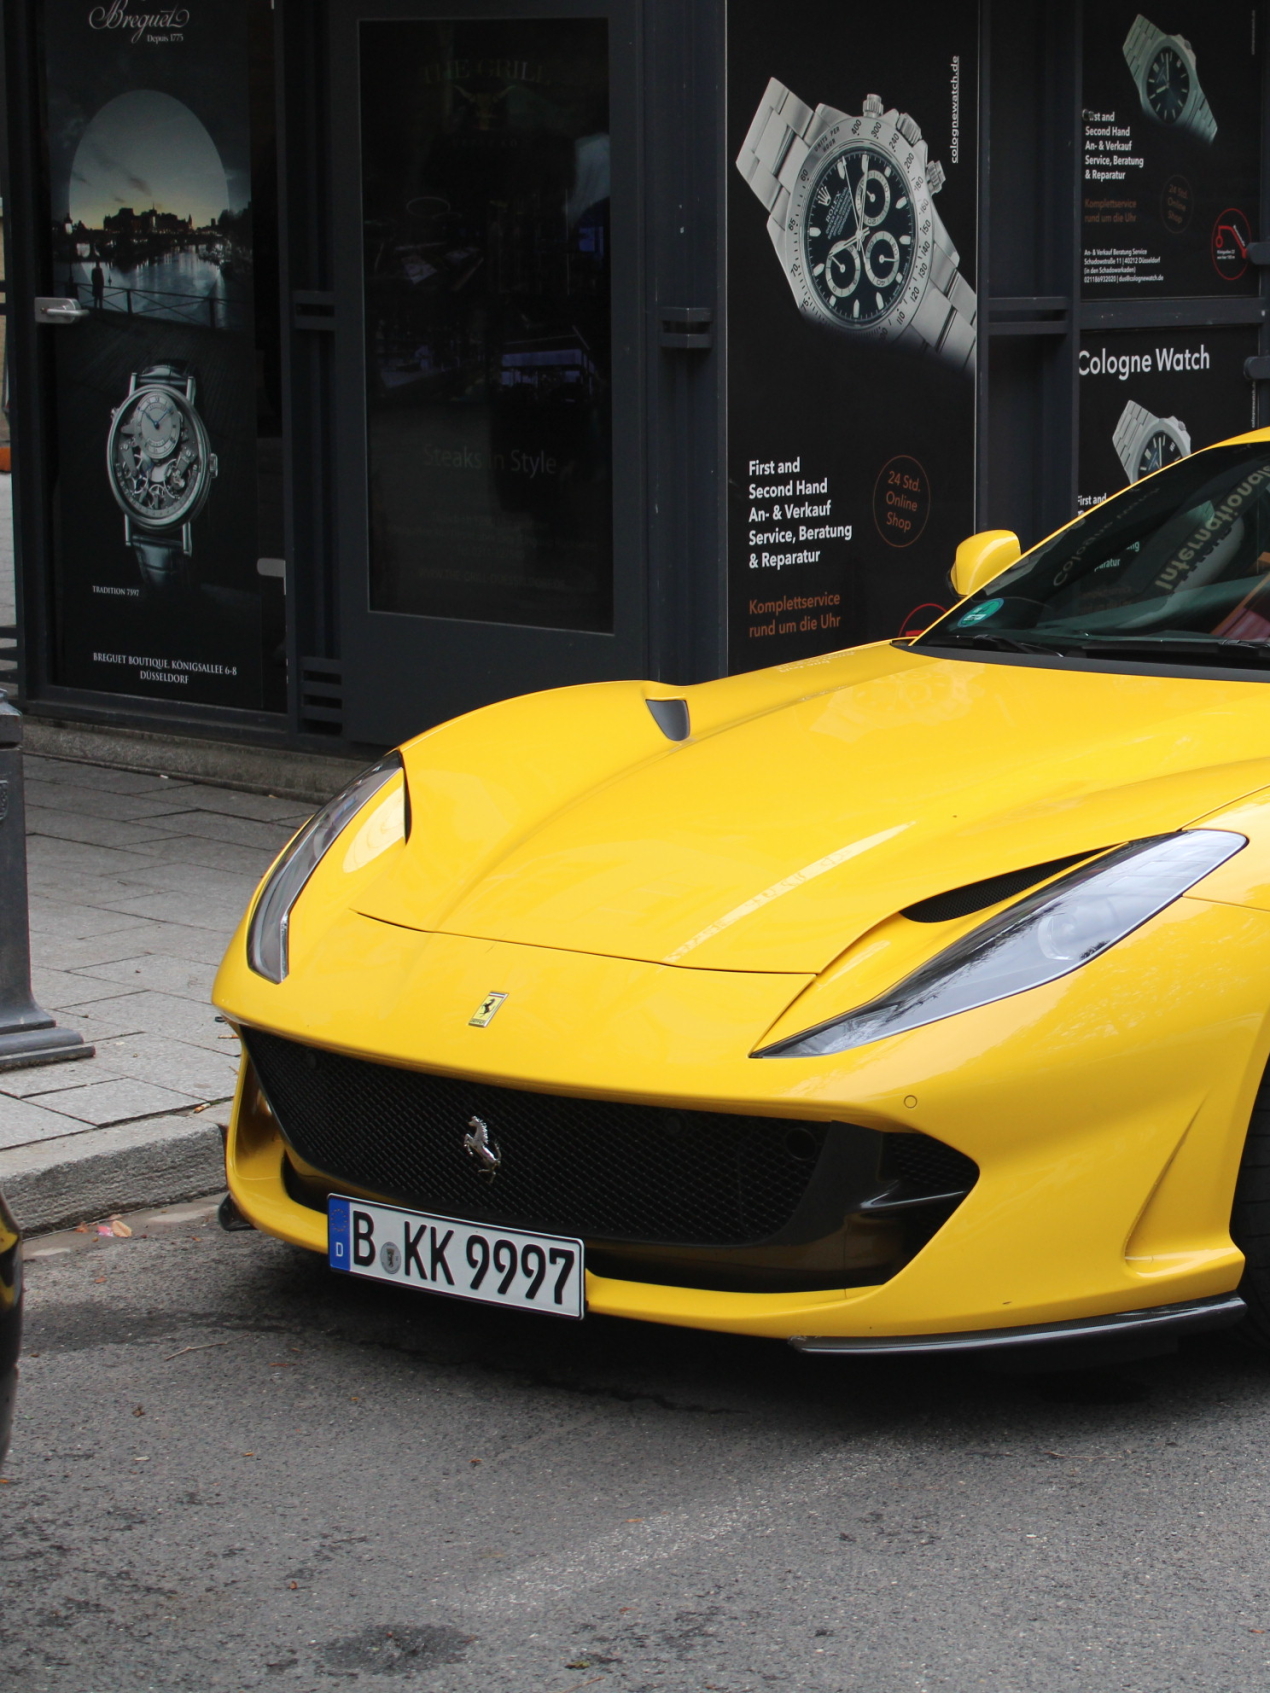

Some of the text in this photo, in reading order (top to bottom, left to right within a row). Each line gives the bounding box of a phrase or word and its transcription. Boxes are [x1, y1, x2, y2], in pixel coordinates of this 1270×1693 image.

[88, 0, 190, 44] Breguet
[950, 55, 960, 164] colognewatch.de
[1102, 111, 1115, 122] and
[1085, 126, 1130, 137] Second Hand
[1085, 140, 1132, 151] An- & Verkauf
[1085, 155, 1144, 168] Service, Beratung
[1085, 170, 1126, 182] & Reparatur
[1085, 198, 1137, 211] Komplettservice
[1168, 197, 1186, 213] Online
[1084, 213, 1100, 222] rund
[1113, 212, 1124, 222] die
[1125, 212, 1136, 222] Uhr
[1168, 211, 1182, 224] Shop
[1079, 344, 1210, 381] Cologne Watch
[423, 443, 483, 469] Steaks
[510, 449, 558, 479] Style
[749, 456, 801, 476] First and
[749, 478, 828, 500] Second Hand
[888, 470, 921, 492] 24 Std.
[748, 500, 832, 522] An- & Verkauf
[886, 490, 918, 512] Online
[886, 512, 912, 533] Shop
[749, 525, 852, 546] Service, Beratung
[749, 550, 820, 570] & Reparatur
[92, 586, 139, 596] TRADITION 7597
[749, 592, 840, 616] Komplettservice
[749, 612, 841, 638] rund um die Uhr
[93, 652, 127, 664] BREGUET
[172, 660, 224, 674] KÖNIGSALLEE
[224, 666, 238, 676] 6-8
[140, 670, 190, 684] DÜSSELDORF
[336, 1242, 344, 1257] D
[353, 1210, 575, 1305] B KK 9997
